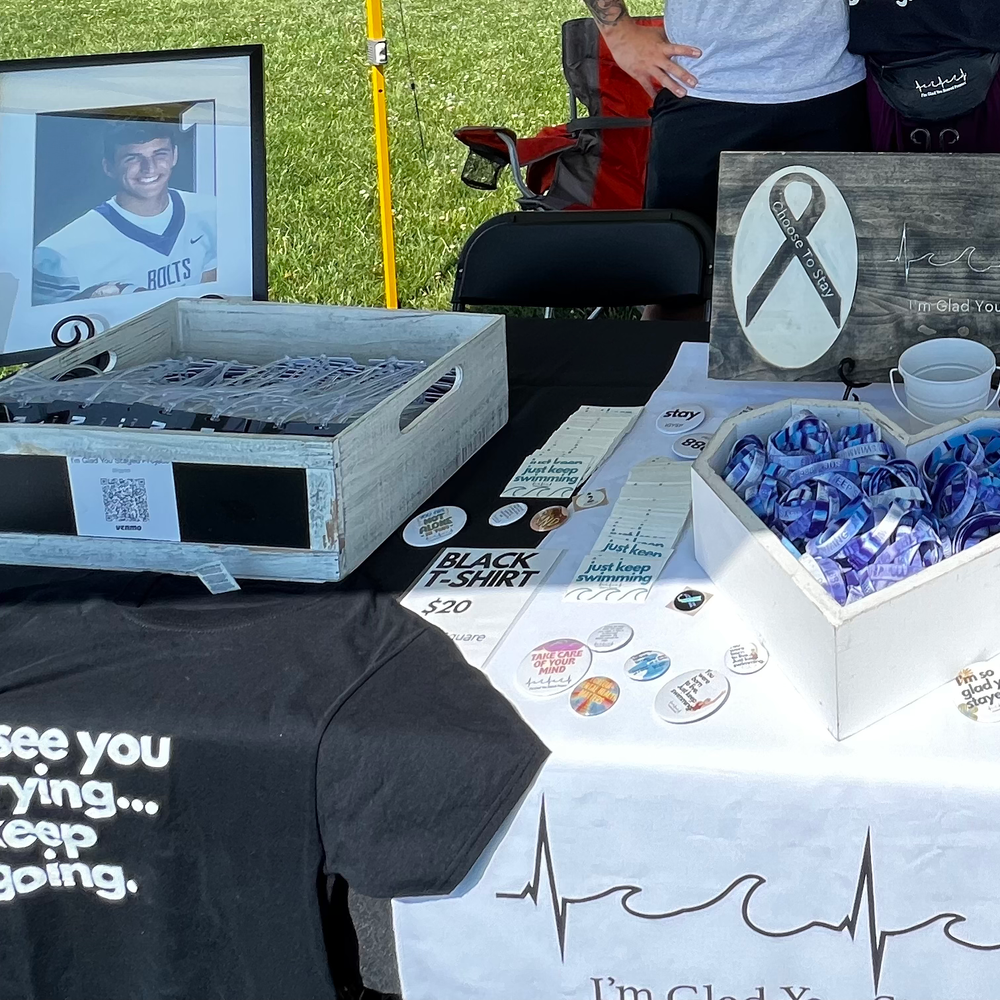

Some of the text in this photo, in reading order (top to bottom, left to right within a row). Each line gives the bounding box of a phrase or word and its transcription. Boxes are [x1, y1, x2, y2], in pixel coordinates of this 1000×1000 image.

[772, 201, 835, 298] Choose To Stay
[147, 257, 191, 291] BOLTS
[909, 299, 931, 313] I'm
[936, 298, 970, 313] Glad
[662, 408, 702, 421] stay
[522, 464, 579, 476] just keep
[512, 472, 579, 485] swimming
[435, 552, 540, 569] BLACK
[584, 557, 652, 574] just keep
[424, 570, 541, 588] T-SHIRT
[575, 571, 653, 584] swimming
[421, 597, 473, 616] $20
[447, 632, 487, 643] quare
[531, 649, 585, 662] TAKE CARE
[533, 657, 576, 668] OF YOUR
[538, 665, 567, 676] MIND
[955, 668, 995, 687] I'm so
[961, 677, 993, 700] glad
[76, 730, 171, 775] you
